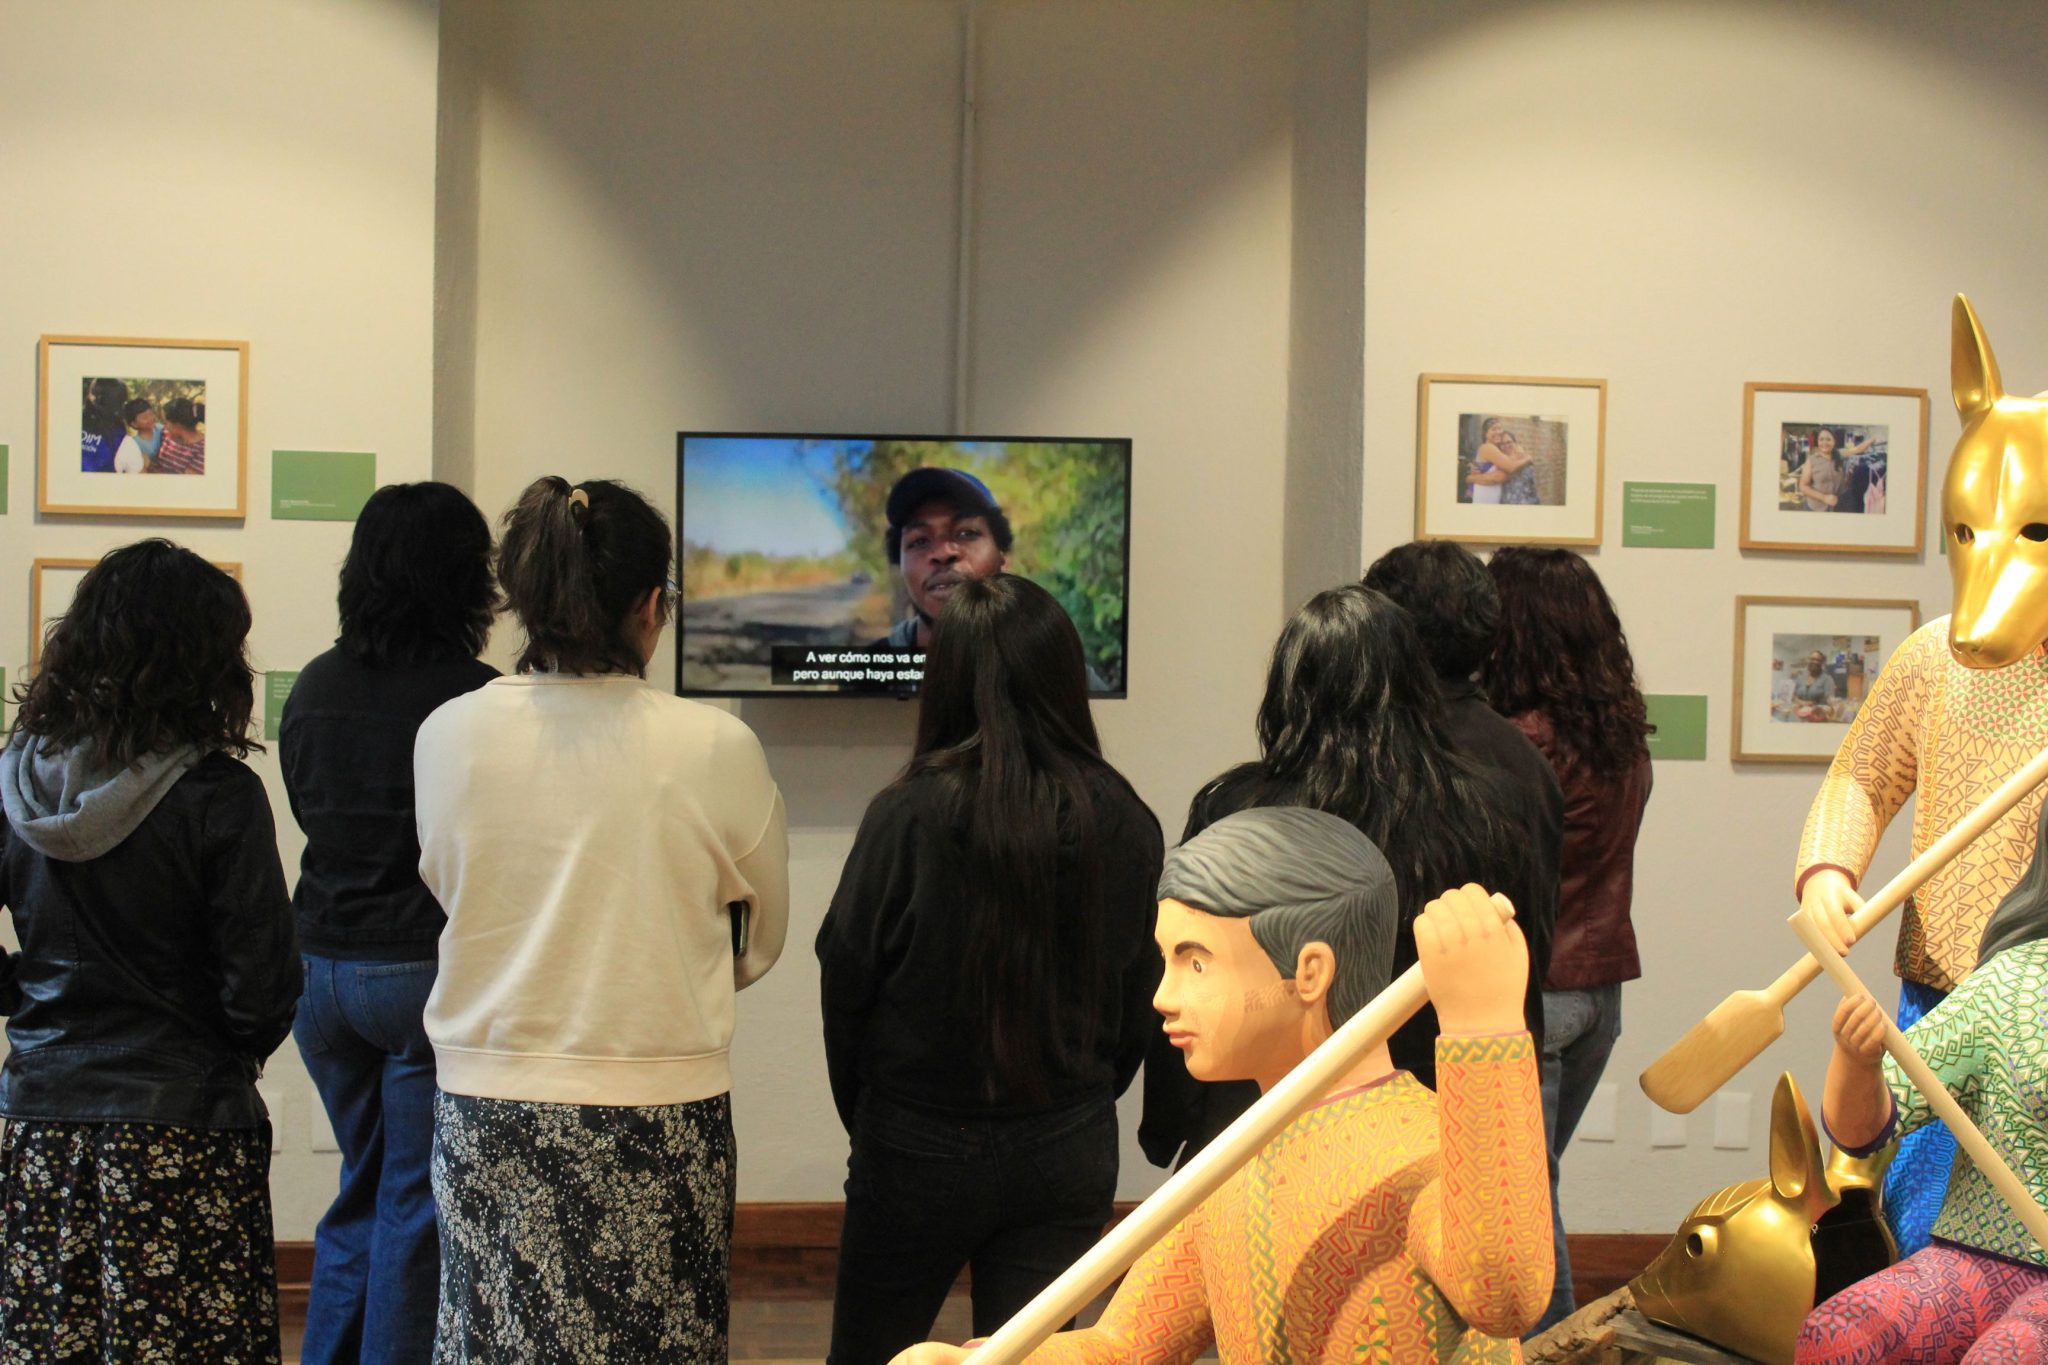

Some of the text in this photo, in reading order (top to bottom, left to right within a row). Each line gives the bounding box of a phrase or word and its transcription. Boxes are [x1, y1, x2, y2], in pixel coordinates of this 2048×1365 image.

[806, 651, 816, 663] A
[818, 653, 836, 663] ver
[839, 651, 870, 664] cómo
[873, 653, 894, 664] nos
[896, 653, 911, 664] va
[793, 670, 819, 682] pero
[821, 670, 865, 682] aunque
[866, 668, 894, 682] haya
